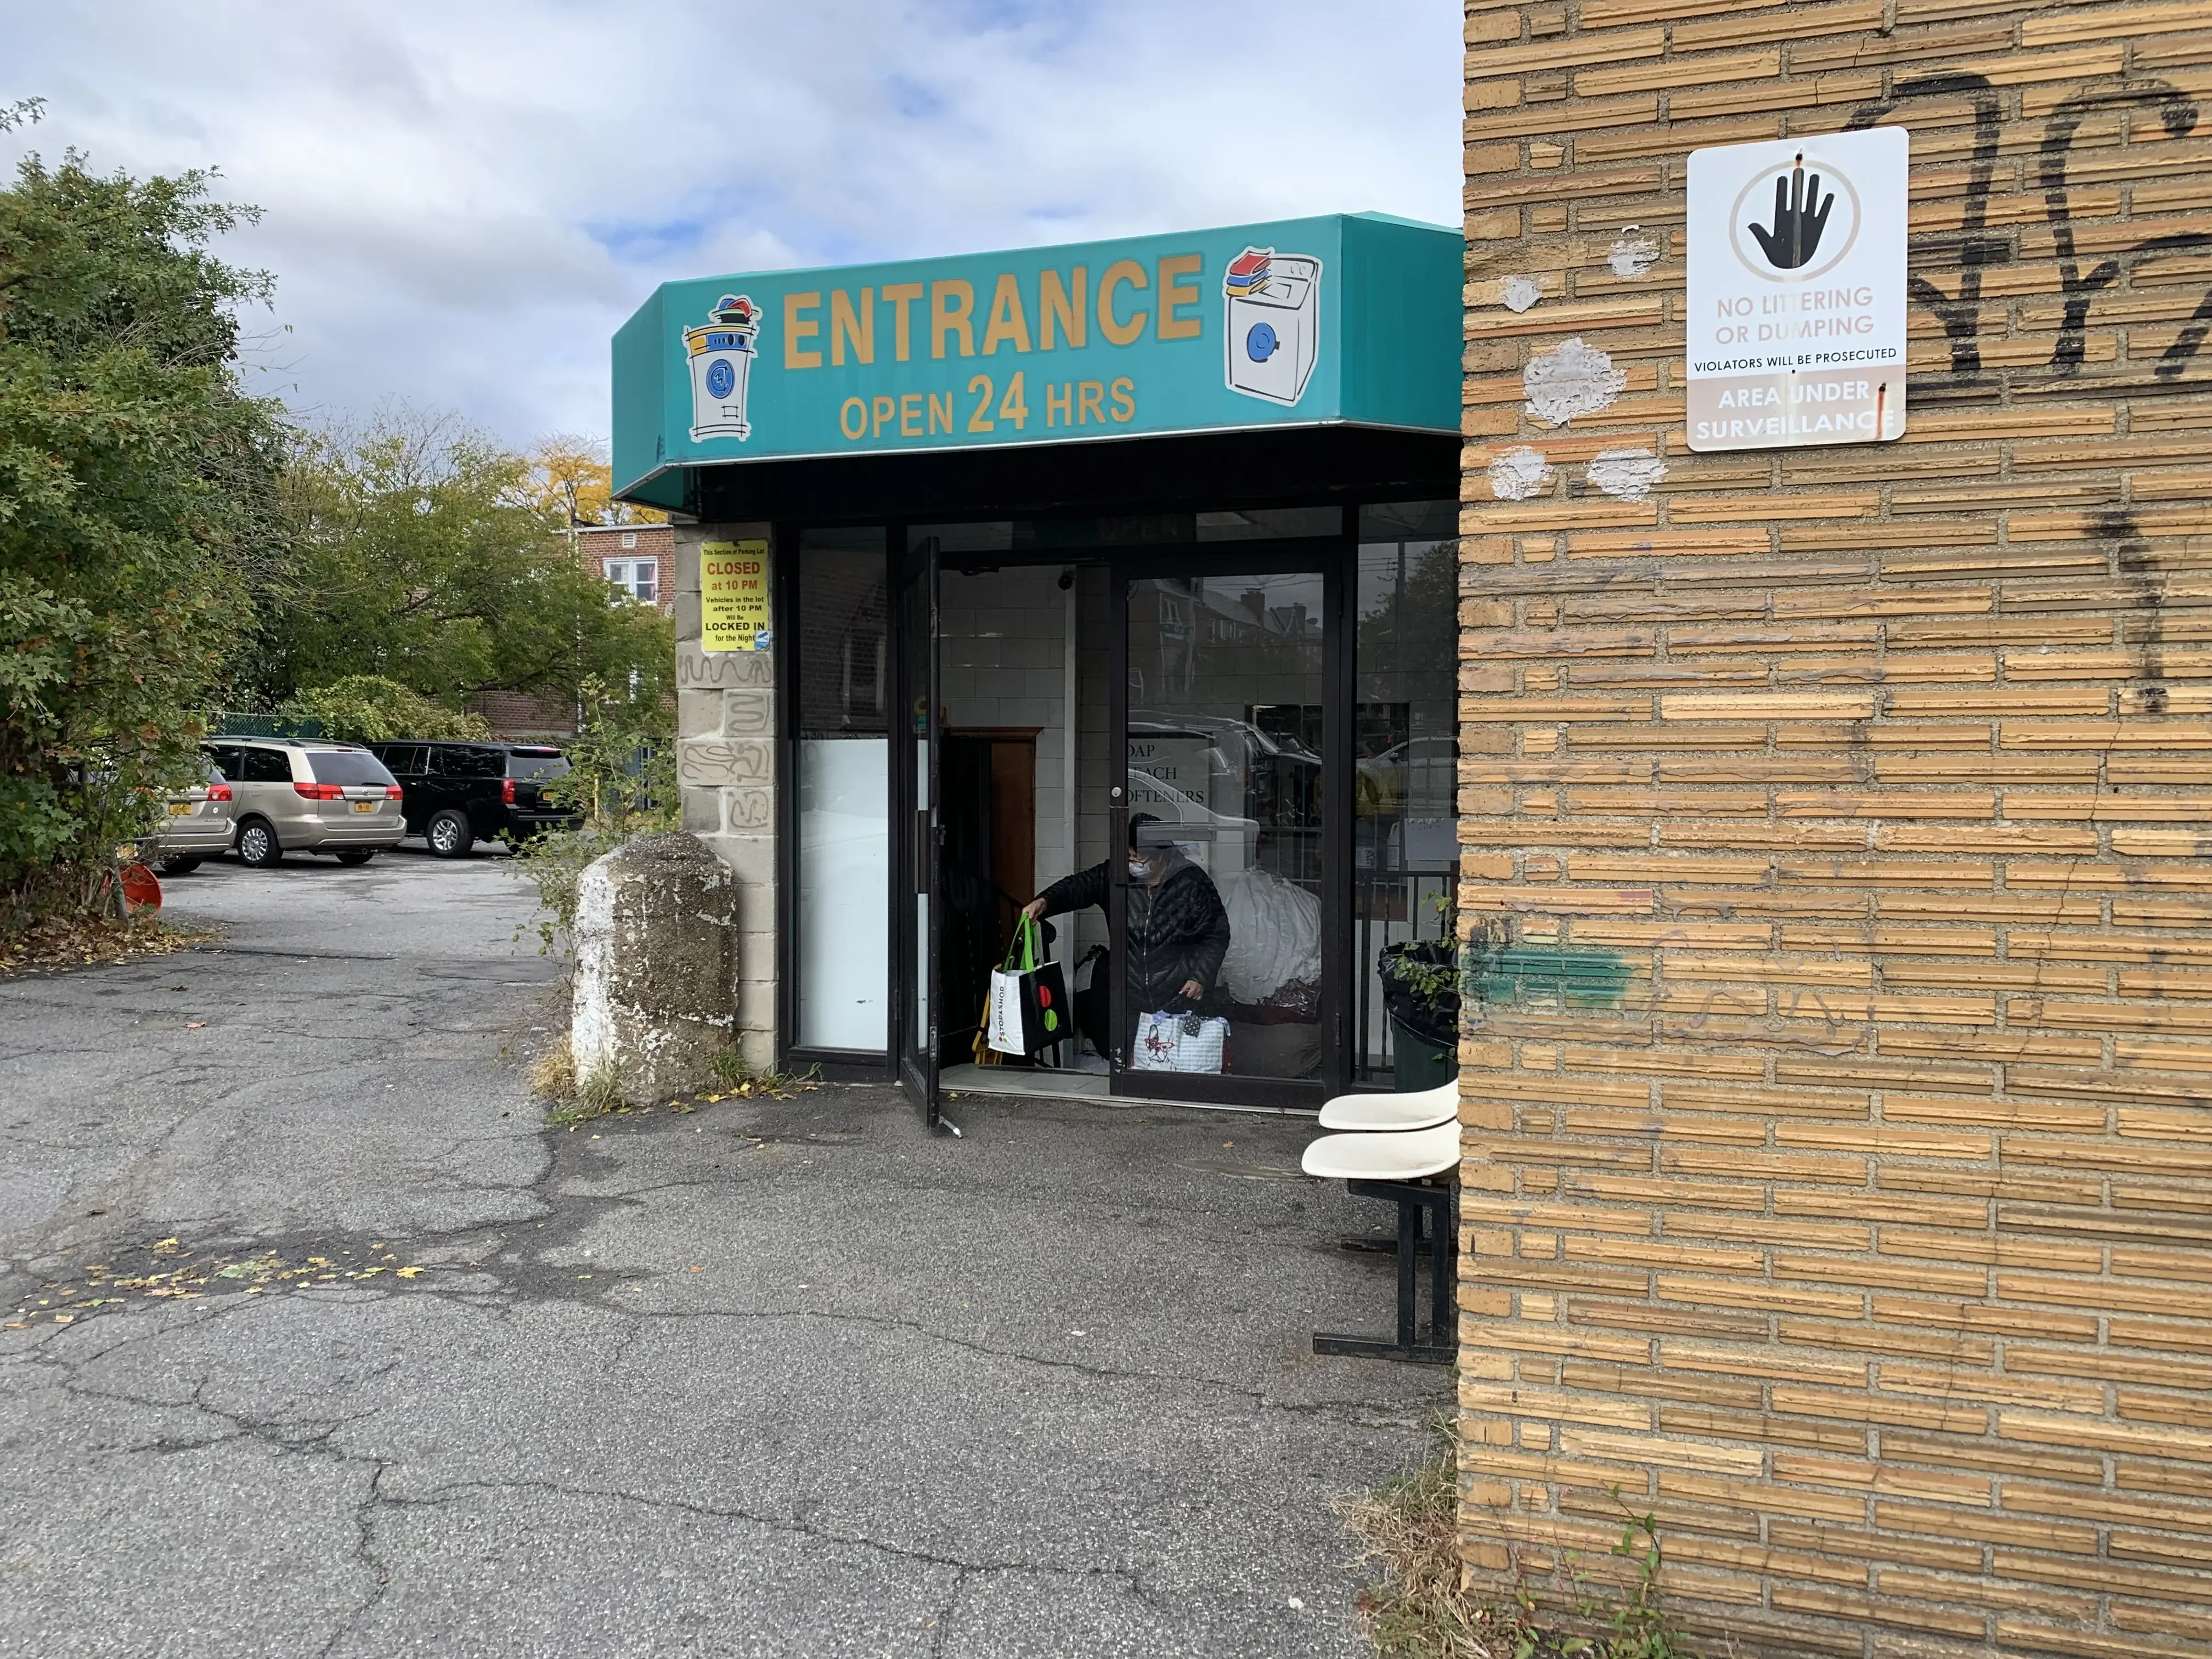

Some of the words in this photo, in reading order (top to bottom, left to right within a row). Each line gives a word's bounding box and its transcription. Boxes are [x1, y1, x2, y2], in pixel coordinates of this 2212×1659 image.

[784, 255, 1201, 370] ENTRANCE
[1717, 297, 1753, 318] NO
[1763, 286, 1874, 314] LITTERING
[1716, 326, 1749, 345] OR
[1758, 315, 1874, 342] DUMPING
[1695, 358, 1762, 372] VIOLATORS
[1767, 356, 1793, 367] WILL
[1798, 354, 1811, 365] BE
[1816, 348, 1897, 364] PROSECUTED
[840, 392, 953, 439] OPEN
[967, 371, 1029, 433] 24
[1047, 377, 1135, 427] HRS
[1718, 387, 1781, 409] AREA
[1790, 380, 1870, 404] UNDER
[1696, 409, 1894, 439] SURVEILLANCE
[707, 562, 760, 575] CLOSED
[712, 582, 722, 590] at
[726, 580, 738, 590] 10
[742, 580, 757, 589] PM
[706, 622, 749, 630] LOCKED
[738, 634, 755, 642] Night
[1128, 744, 1155, 757] OAP
